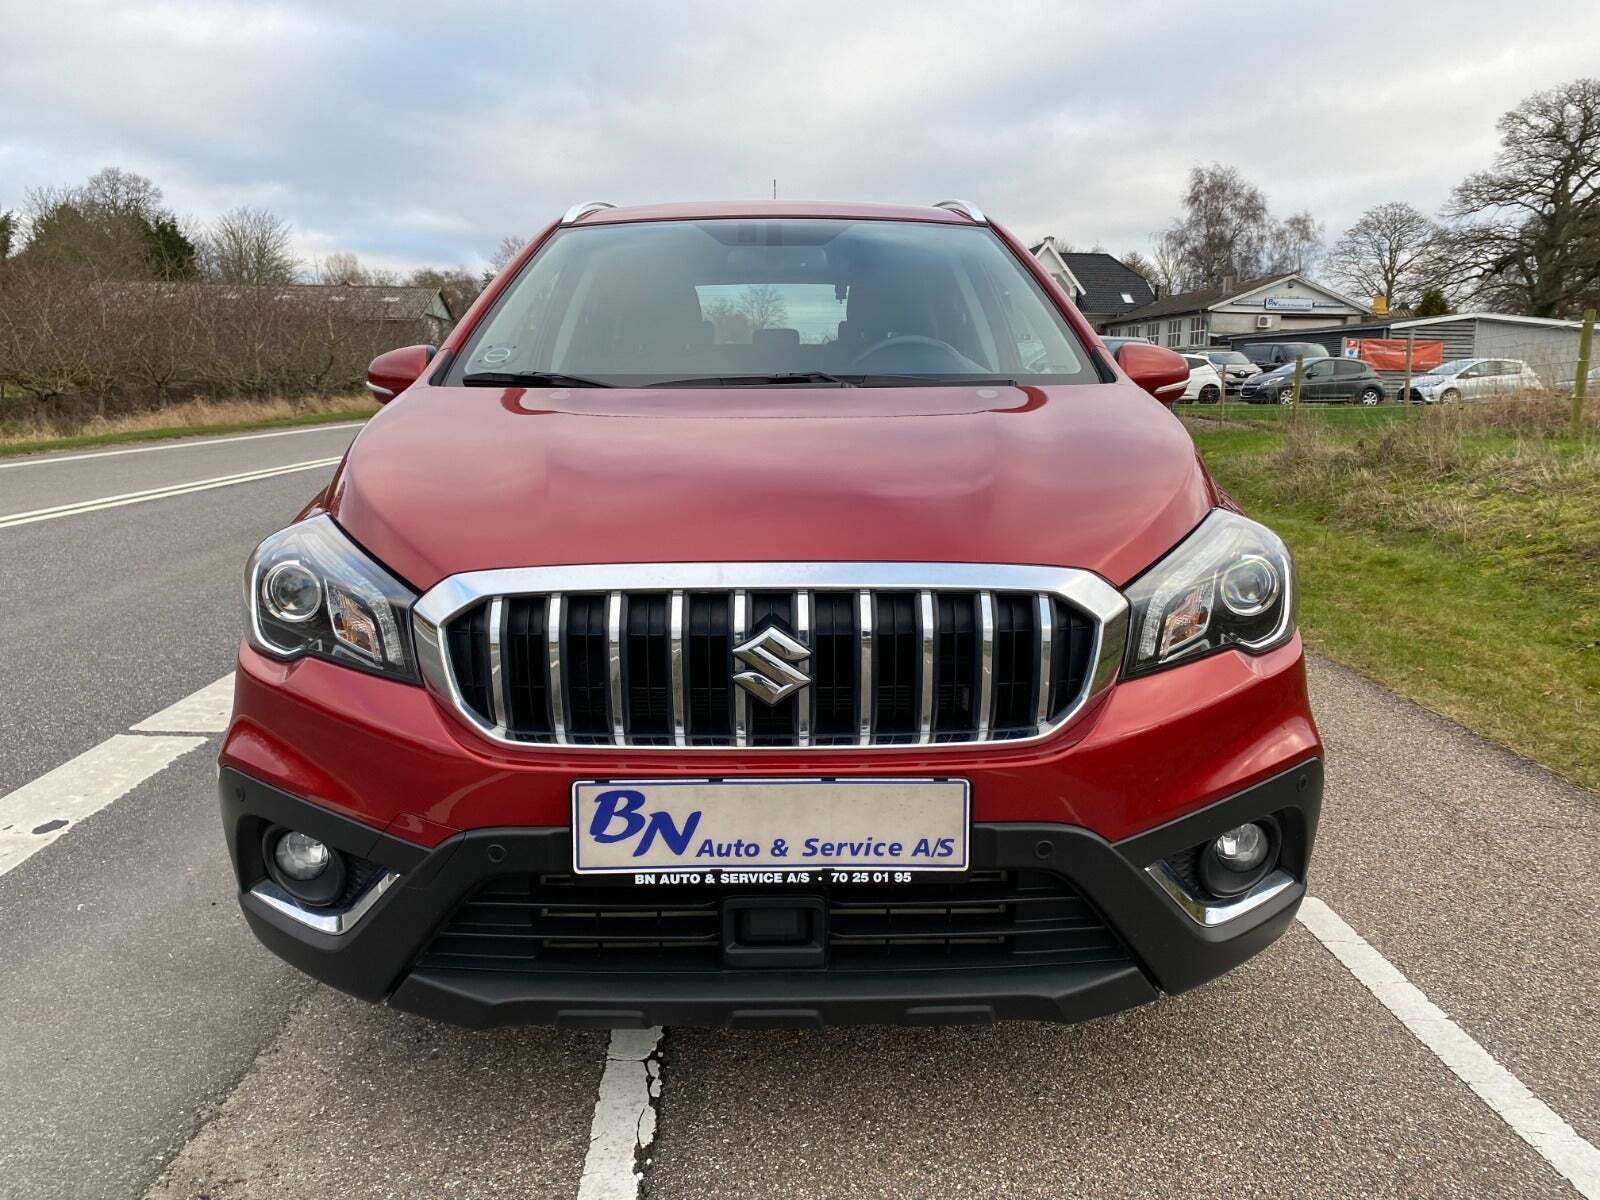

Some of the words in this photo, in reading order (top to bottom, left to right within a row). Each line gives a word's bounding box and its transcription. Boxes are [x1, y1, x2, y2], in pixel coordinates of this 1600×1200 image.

[589, 789, 702, 857] BN
[696, 839, 760, 857] Auto
[770, 838, 789, 857] &
[802, 837, 903, 857] Service
[911, 837, 955, 858] A/S
[634, 874, 656, 885] BN
[659, 874, 701, 885] AUTO
[704, 874, 716, 884] &
[720, 873, 783, 884] SERVICE
[786, 872, 810, 883] A/S
[831, 872, 848, 883] 70
[852, 872, 870, 883] 25
[873, 872, 889, 883] 01
[893, 871, 912, 882] 95
